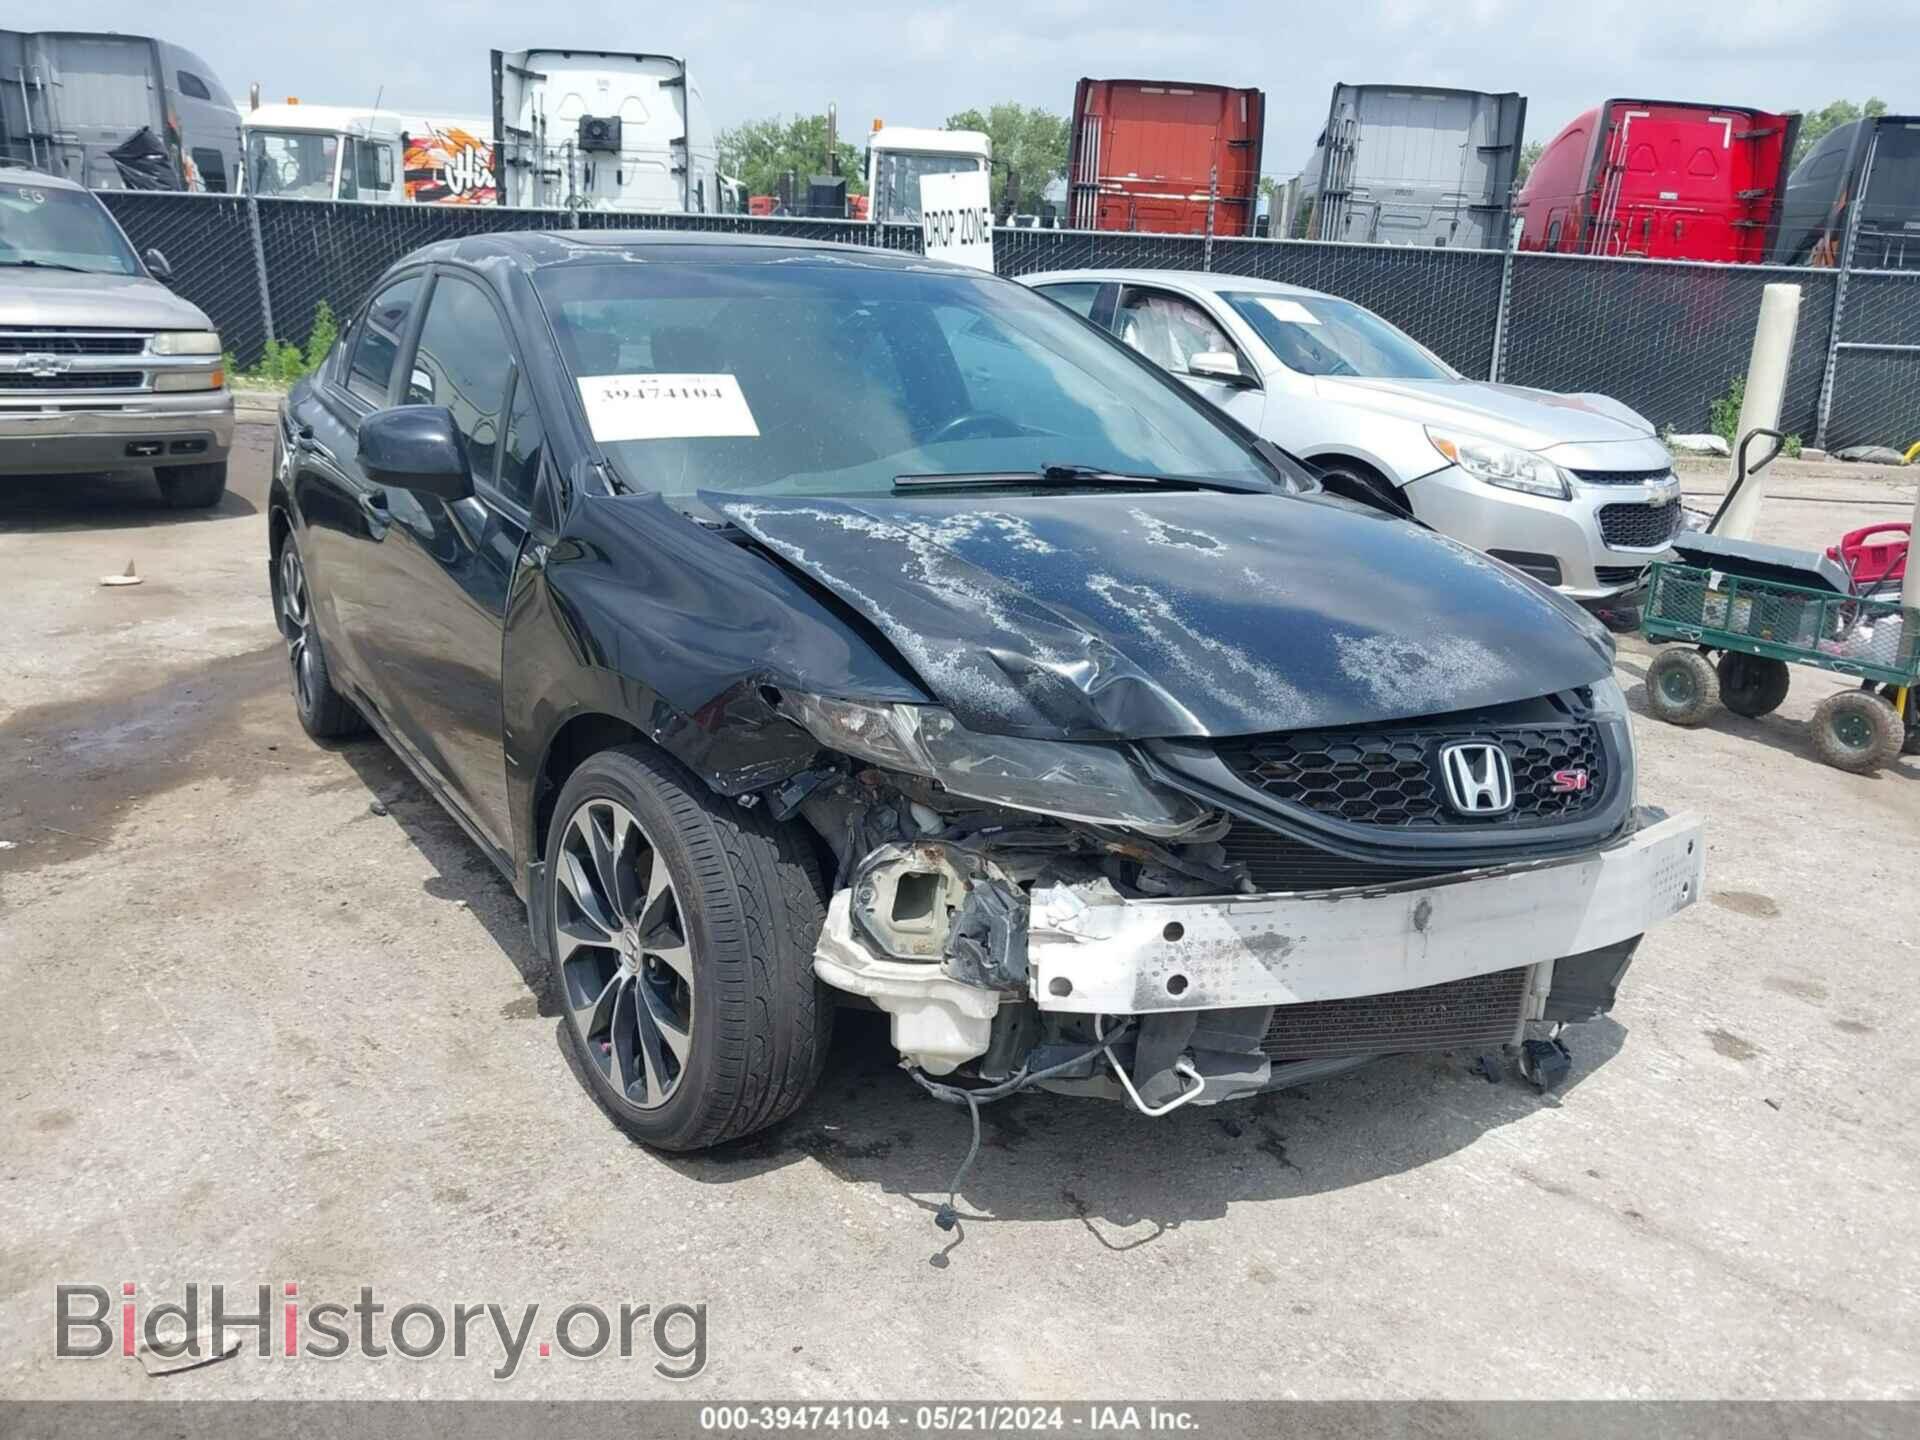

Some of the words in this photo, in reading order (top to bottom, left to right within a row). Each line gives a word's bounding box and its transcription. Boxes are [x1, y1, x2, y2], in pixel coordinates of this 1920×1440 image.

[924, 208, 955, 248] DROP
[959, 206, 990, 246] ZONE
[1552, 769, 1588, 793] Si
